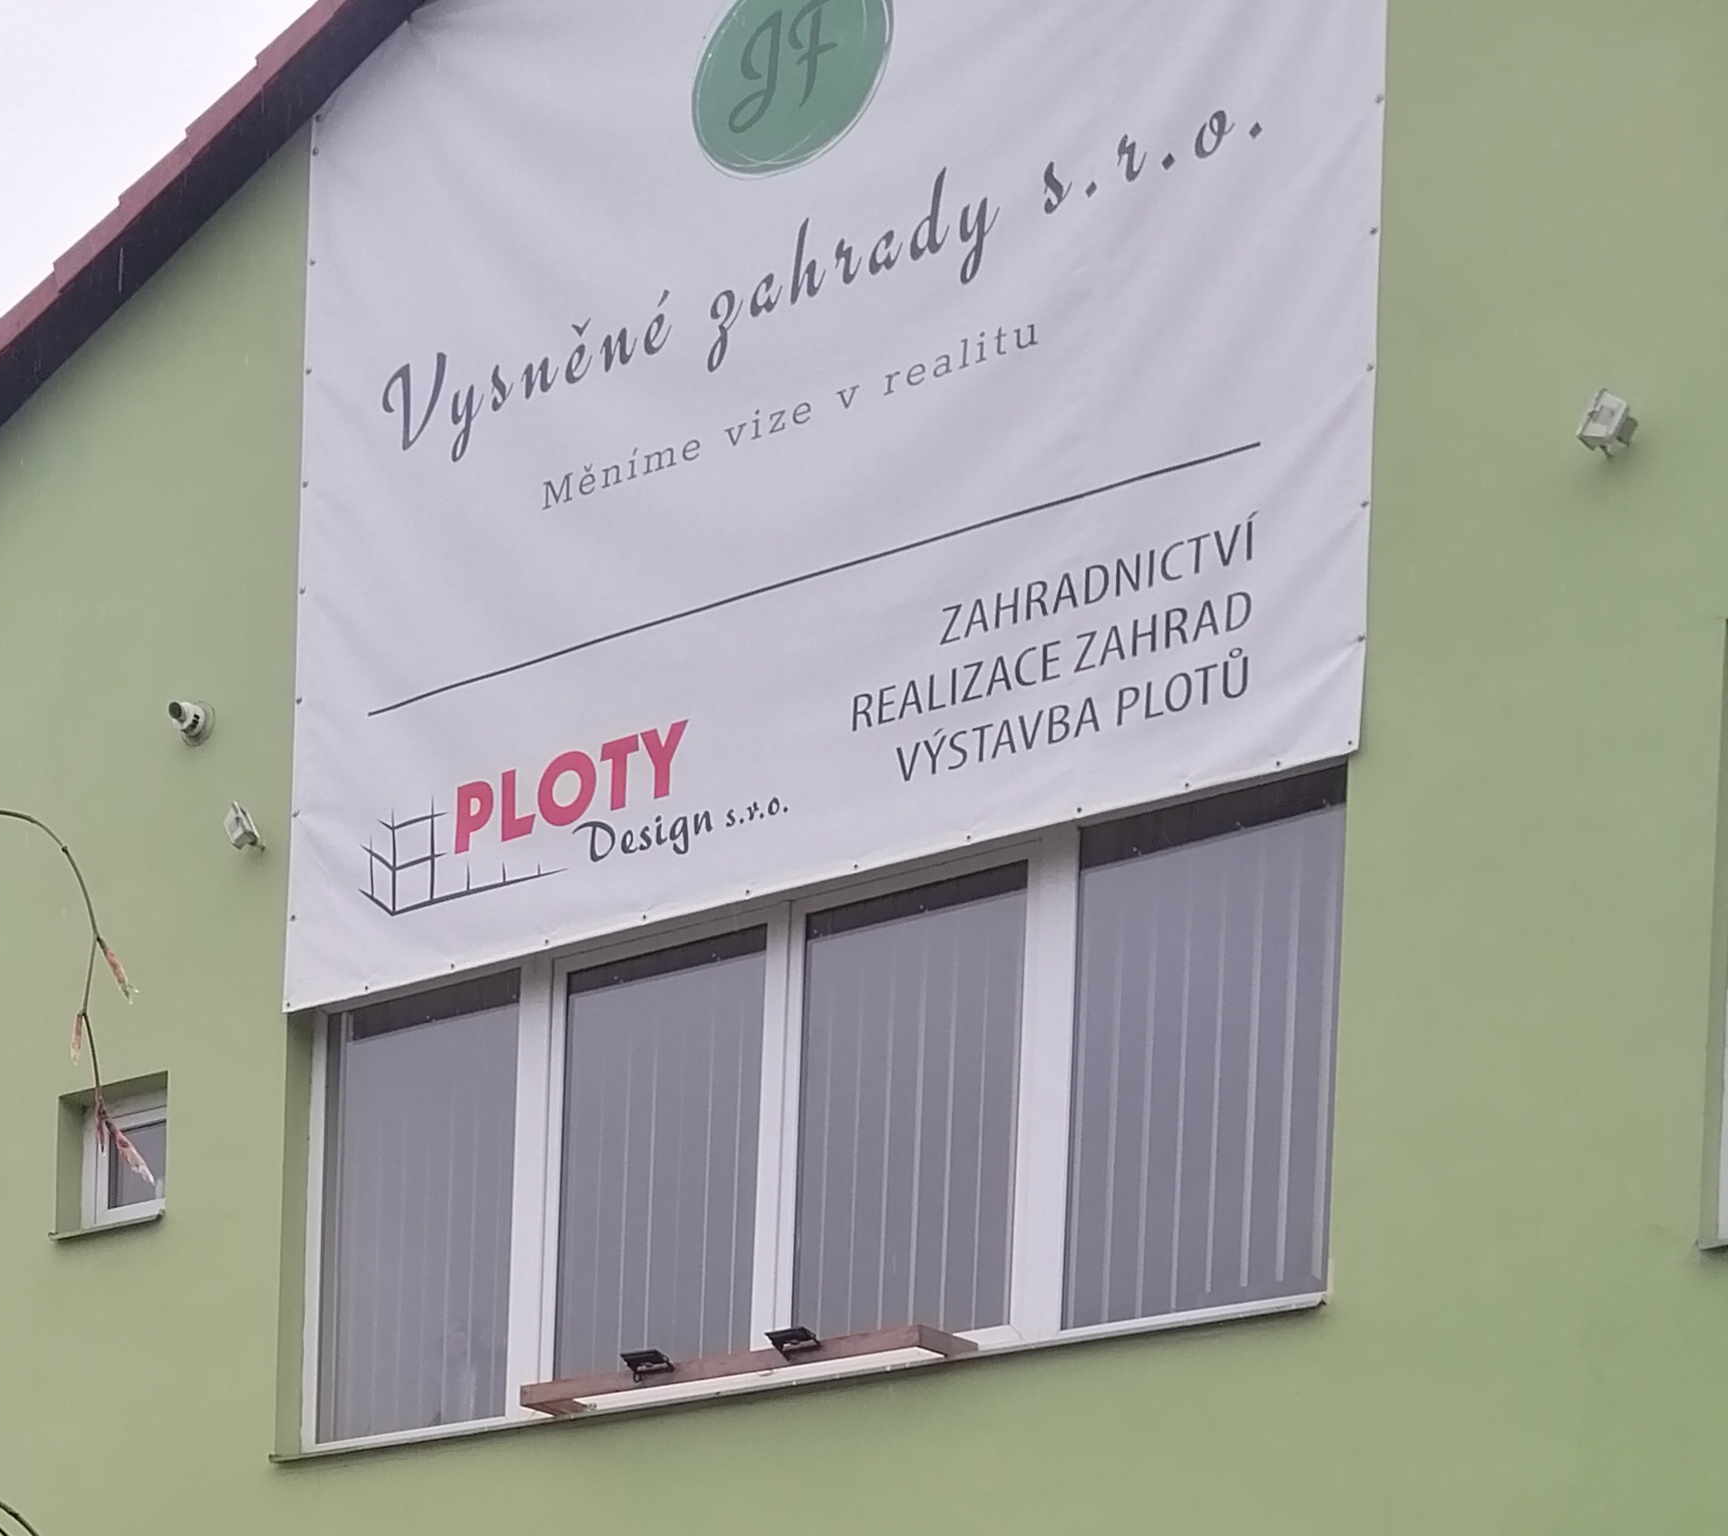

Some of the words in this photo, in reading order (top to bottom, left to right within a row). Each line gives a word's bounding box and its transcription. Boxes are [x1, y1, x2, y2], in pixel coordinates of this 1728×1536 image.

[381, 289, 672, 462] Vysněné
[707, 166, 1000, 373] zahrady
[1043, 110, 1264, 214] s.r.o.
[541, 438, 702, 510] Měníme
[724, 400, 813, 448] vize
[836, 383, 861, 410] v
[883, 322, 1040, 396] realitu
[939, 511, 1260, 646] ZAHRADNICTVÍ
[851, 640, 1062, 733] REALIZACE
[1073, 591, 1253, 674] ZAHRAD
[895, 697, 1101, 783] VÝSTAVBA
[1116, 647, 1250, 728] PLOTŮ
[454, 718, 690, 855] PLOTY
[572, 809, 713, 862] Design
[725, 796, 789, 828] s.r.o.
